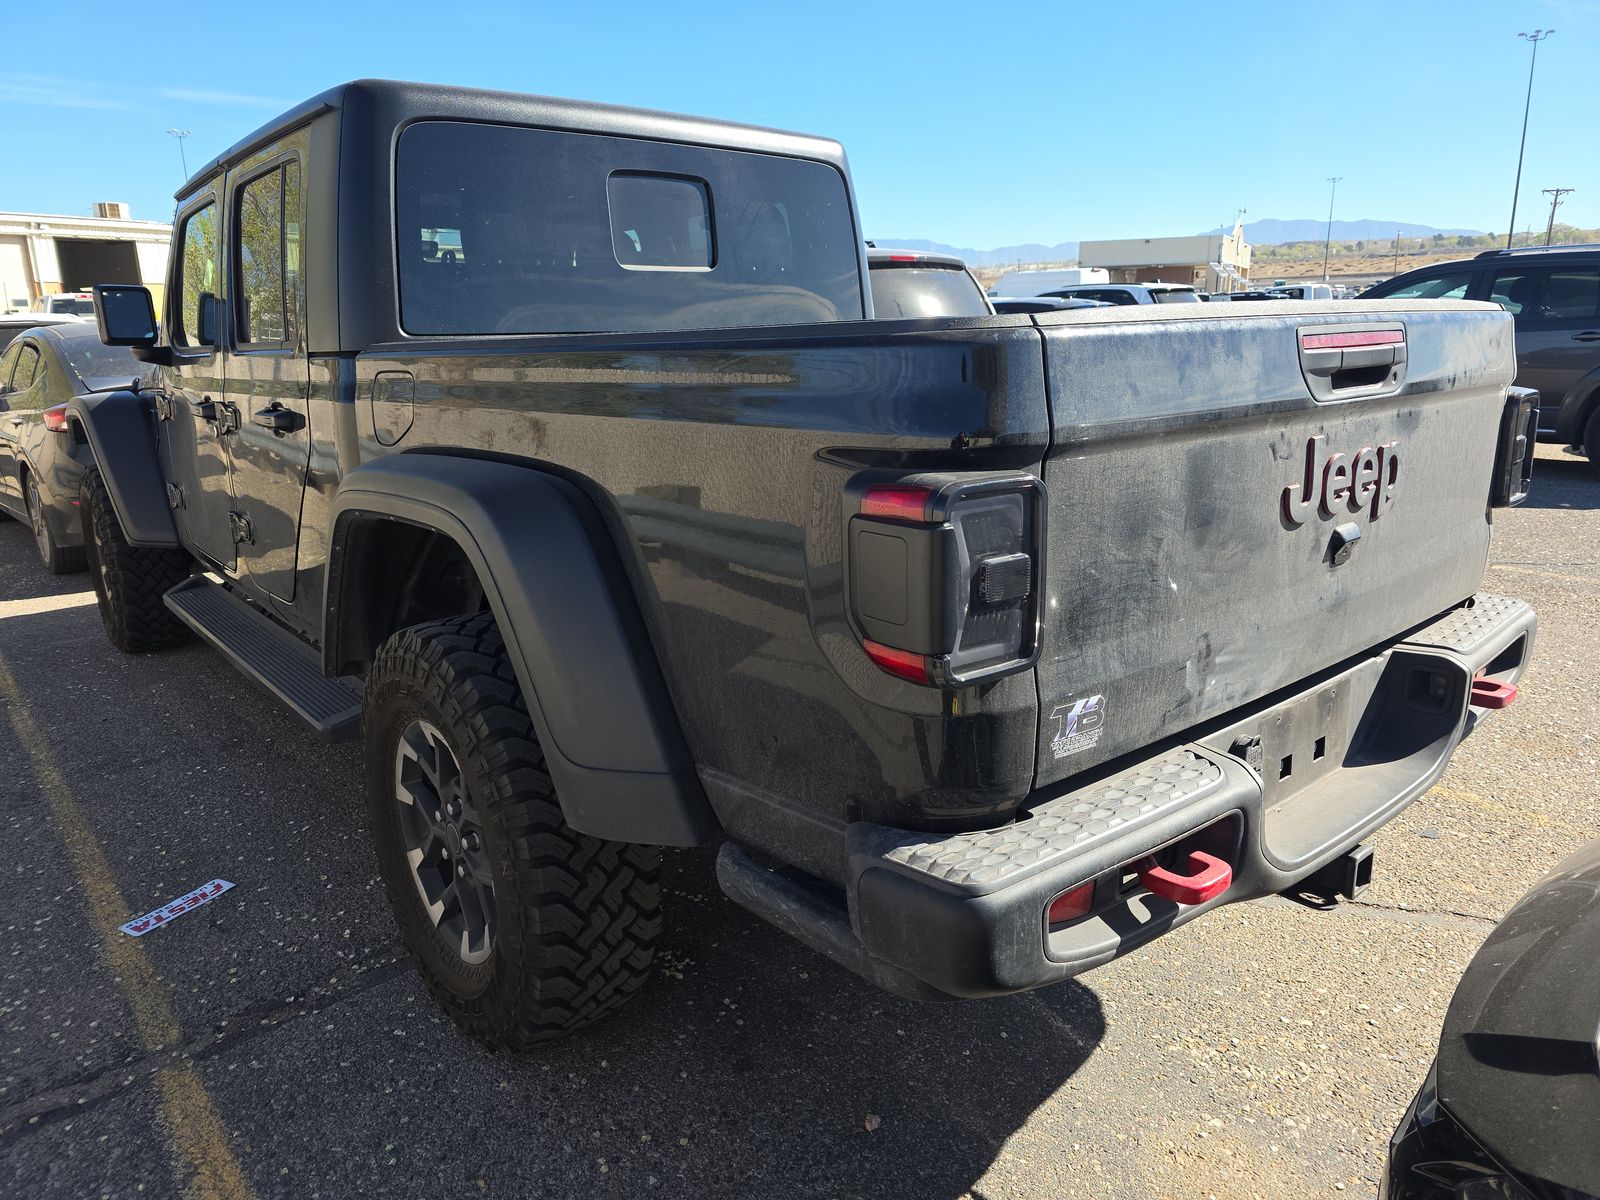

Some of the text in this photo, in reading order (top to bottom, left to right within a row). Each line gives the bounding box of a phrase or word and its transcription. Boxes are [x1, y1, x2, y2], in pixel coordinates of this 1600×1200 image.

[1282, 435, 1401, 525] Jeep
[126, 881, 215, 928] AUTO GROUP
[130, 883, 223, 932] FIESTA
